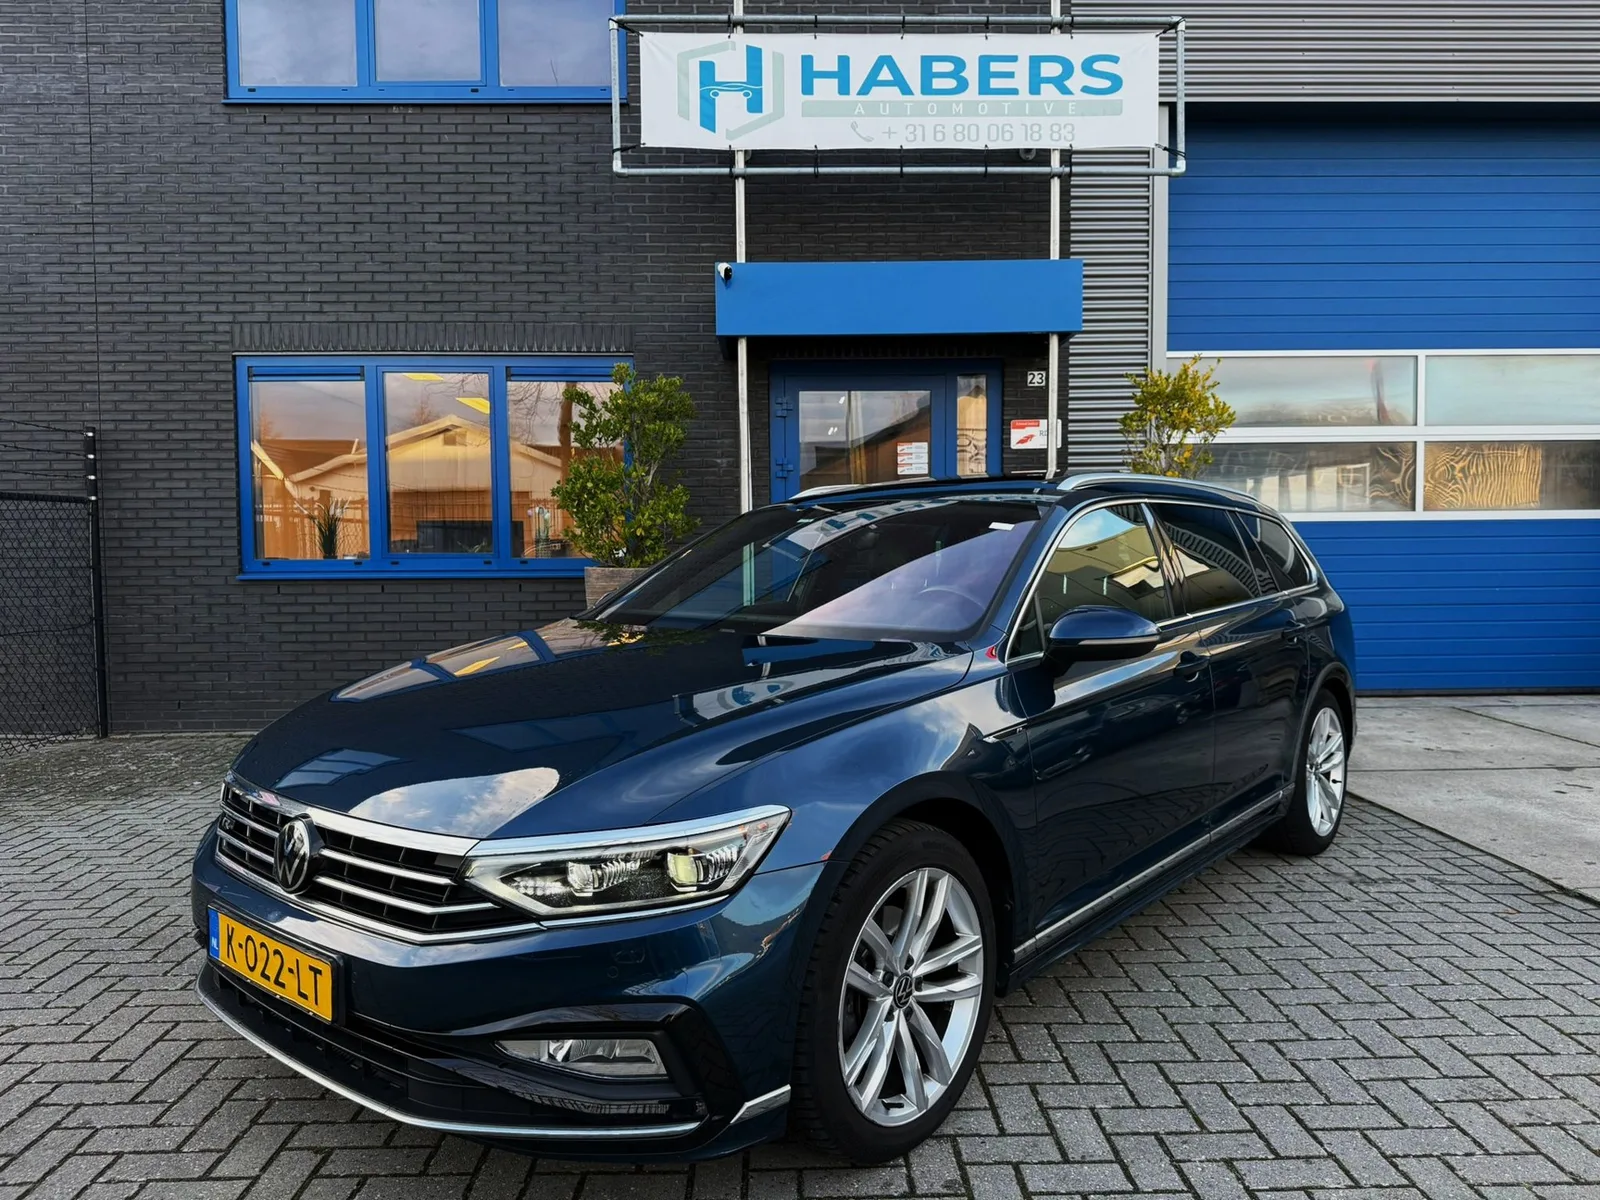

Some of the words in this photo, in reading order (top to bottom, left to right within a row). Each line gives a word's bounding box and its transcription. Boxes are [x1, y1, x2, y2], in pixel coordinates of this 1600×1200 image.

[801, 54, 1123, 96] HABERS
[854, 102, 1076, 115] AUTOMOTIVE
[953, 124, 980, 142] 80
[987, 124, 1014, 142] 06
[1021, 123, 1042, 142] 18
[1050, 123, 1075, 142] 83
[1028, 372, 1044, 385] 23
[211, 936, 219, 950] NL
[226, 923, 323, 1006] K-022-LT
